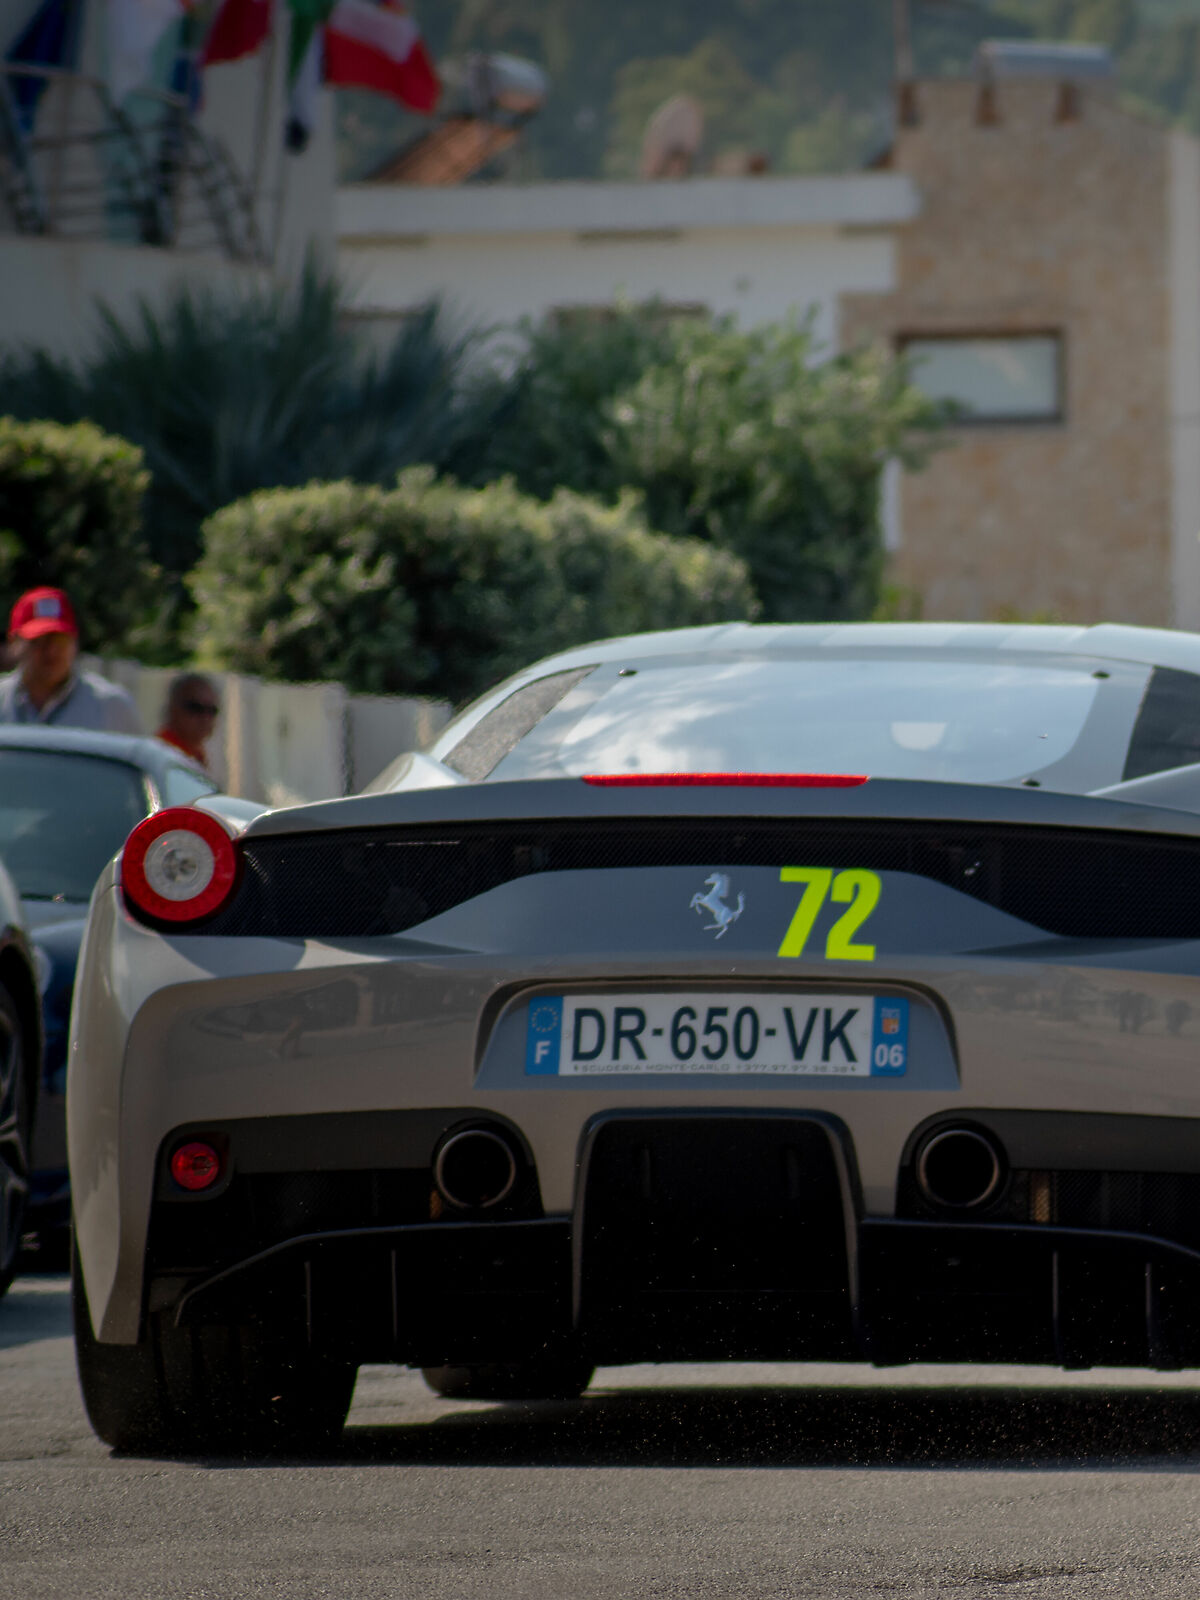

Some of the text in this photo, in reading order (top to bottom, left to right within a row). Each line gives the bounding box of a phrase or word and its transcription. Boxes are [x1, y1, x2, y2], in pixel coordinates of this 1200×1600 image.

[778, 866, 882, 961] 72
[572, 1007, 860, 1061] DR-650-VK
[535, 1040, 551, 1064] F
[875, 1043, 904, 1068] 06
[582, 1063, 641, 1073] SCUDERIA
